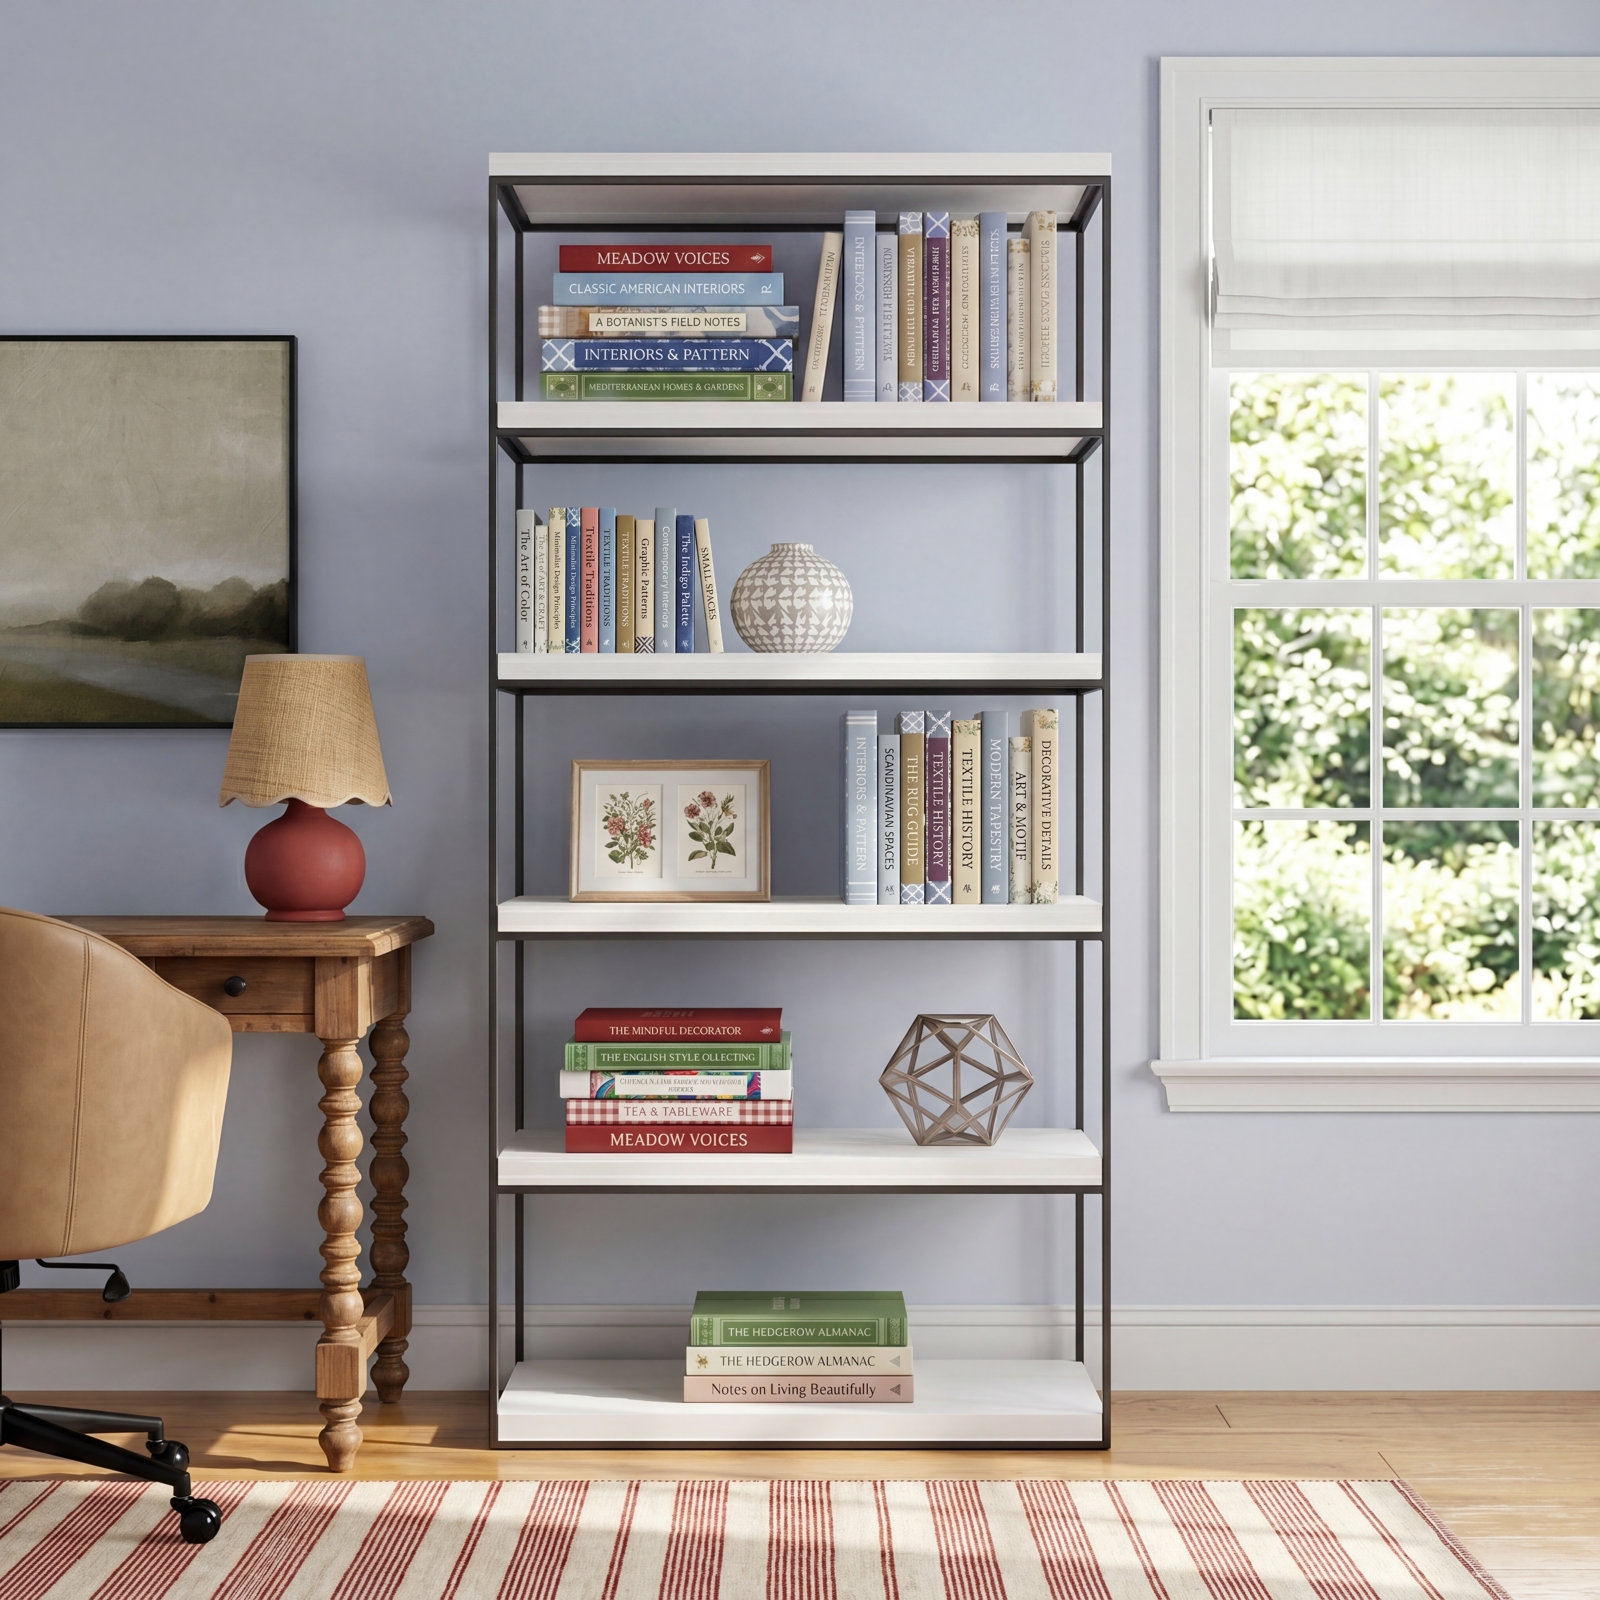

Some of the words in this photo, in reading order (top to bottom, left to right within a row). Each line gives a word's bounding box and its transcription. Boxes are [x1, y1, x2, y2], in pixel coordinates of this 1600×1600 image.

[597, 252, 669, 264] MEADOW
[674, 252, 729, 264] VOICES
[569, 284, 616, 294] CLASSIC
[620, 284, 680, 294] AMERICAN
[684, 284, 744, 294] INTERIORS
[596, 318, 603, 327] A
[607, 318, 667, 327] BOTANIST'S
[672, 318, 700, 327] FIELD
[705, 318, 740, 327] NOTES
[585, 349, 662, 360] INTERIORS
[667, 349, 679, 360] &
[683, 349, 749, 360] PATTERN
[521, 529, 530, 550] The
[682, 533, 690, 552] The
[521, 554, 530, 572] Art
[640, 538, 649, 576] Graphic
[661, 527, 670, 588] Contemporary
[679, 556, 690, 589] Indigo
[521, 576, 530, 587] of
[701, 547, 711, 581] SMALL
[706, 584, 716, 620] SPACES
[521, 590, 530, 622] Color
[586, 571, 594, 628] Traditions
[682, 592, 690, 626] Palette
[856, 737, 866, 800] INTERIORS
[907, 755, 918, 783] THE
[933, 752, 943, 806] TEXTILE
[962, 749, 972, 805] TEXTILE
[990, 739, 1001, 799] MODERN
[1041, 740, 1051, 817] DECORATIVE
[885, 749, 894, 828] SCANDINAVIAN
[1016, 772, 1026, 798] ART
[856, 804, 866, 814] &
[907, 788, 918, 816] RUG
[1016, 803, 1026, 812] &
[856, 818, 866, 870] PATTERN
[885, 832, 894, 870] SPACES
[907, 820, 918, 865] GUIDE
[933, 810, 943, 867] HISTORY
[962, 810, 972, 869] HISTORY
[990, 804, 1001, 871] TAPESTRY
[1016, 816, 1026, 860] MOTIF
[1041, 821, 1051, 870] DETAILS
[609, 1026, 629, 1035] THE
[632, 1026, 677, 1035] MINDFUL
[680, 1026, 741, 1035] DECORATOR
[624, 1107, 647, 1116] TEA
[651, 1107, 658, 1116] &
[663, 1107, 733, 1116] TABLEWARE
[611, 1133, 685, 1146] MEADOW
[690, 1133, 747, 1146] VOICES
[728, 1328, 749, 1336] THE
[753, 1328, 815, 1336] HEDGEROW
[818, 1328, 871, 1336] ALMANAC
[720, 1356, 742, 1366] THE
[747, 1356, 814, 1366] HEDGEROW
[818, 1356, 875, 1366] ALMANAC
[712, 1384, 747, 1395] Notes
[751, 1386, 765, 1395] on
[771, 1384, 806, 1398] Living
[811, 1383, 876, 1398] Beautifully
